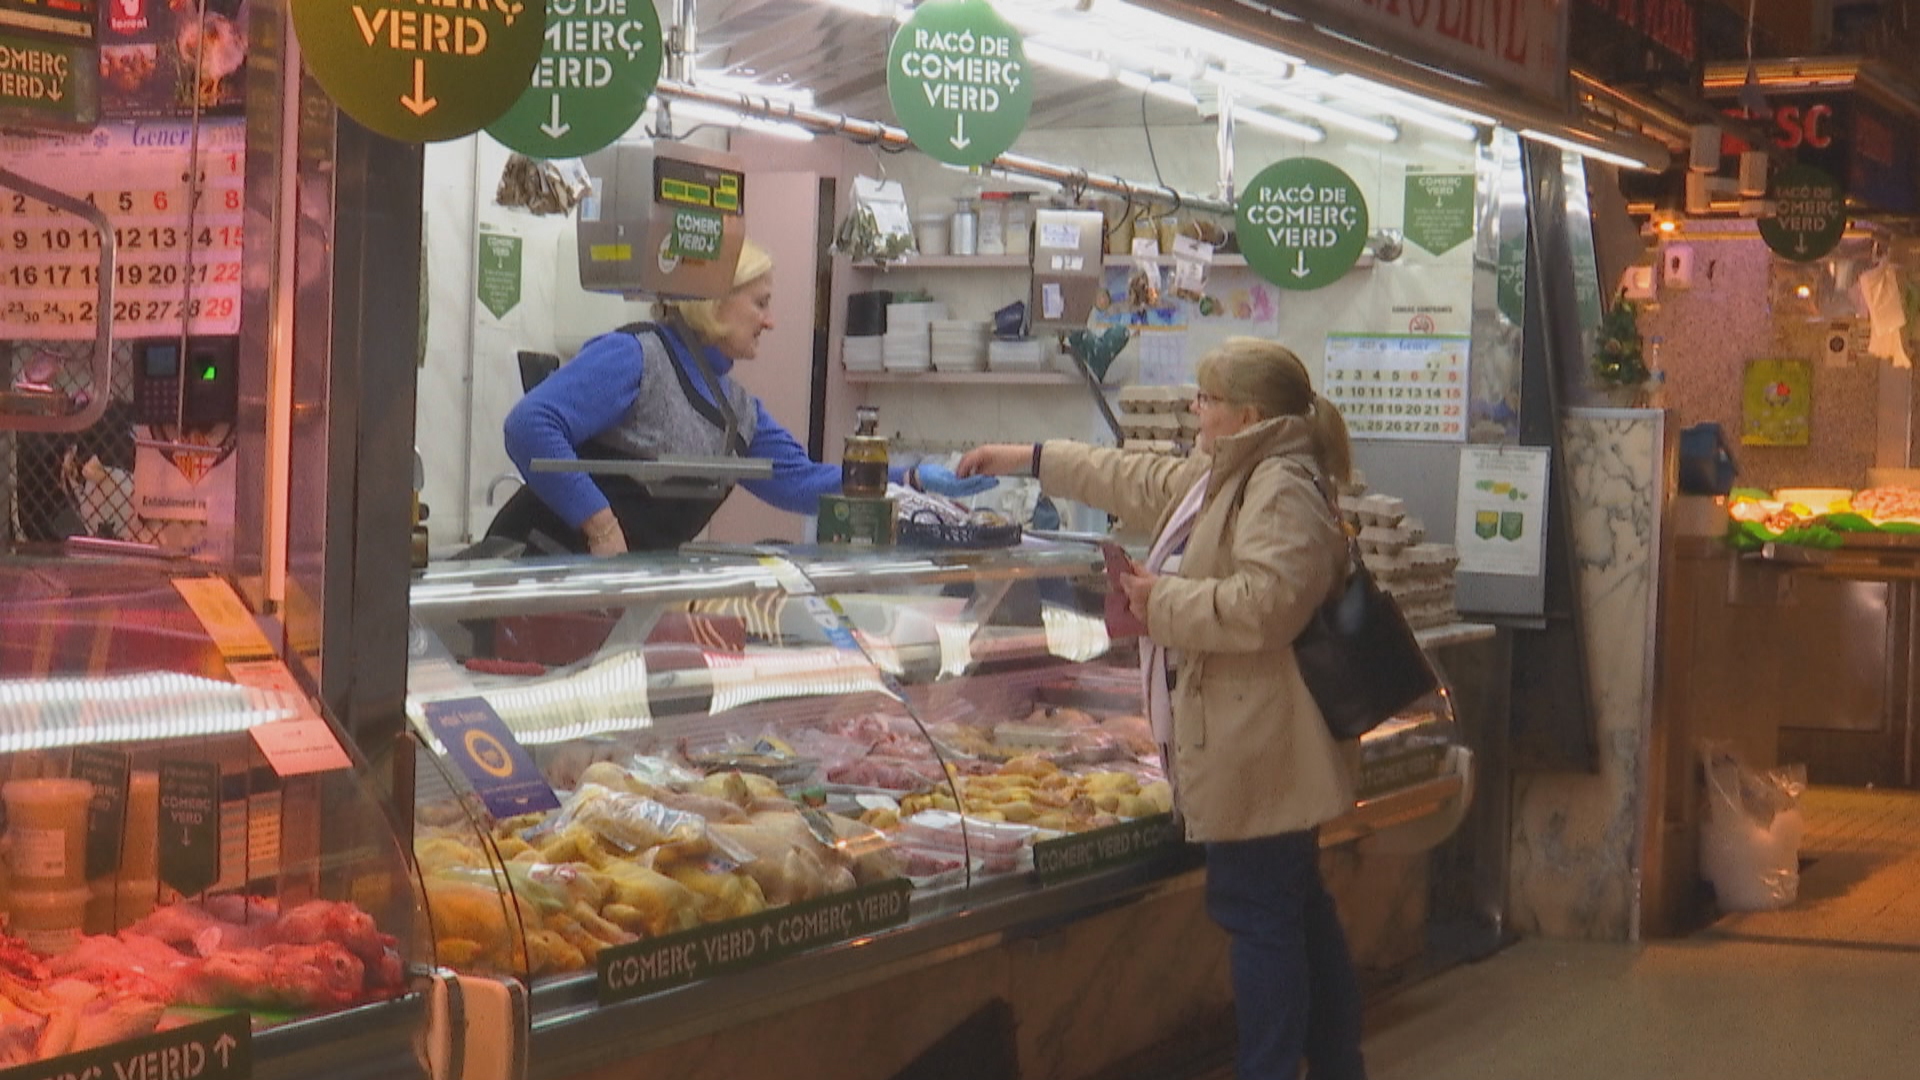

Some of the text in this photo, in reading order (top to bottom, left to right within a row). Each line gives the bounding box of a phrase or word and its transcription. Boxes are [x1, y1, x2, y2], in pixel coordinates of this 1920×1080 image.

[352, 5, 488, 55] VERD
[545, 20, 644, 61] MERÇ
[915, 28, 1009, 57] RACÓ DE
[0, 45, 68, 82] OMERÇ
[531, 57, 613, 88] ERD
[901, 51, 1021, 94] COMERÇ
[0, 73, 44, 98] ERD
[922, 81, 1000, 113] VERD
[12, 195, 26, 213] 2
[119, 192, 132, 212] 5
[153, 191, 168, 211] 6
[225, 190, 239, 209] 8
[1260, 183, 1347, 204] RACÓ DE
[1247, 204, 1357, 232] COMERÇ
[1777, 199, 1839, 220] OMERÇ
[677, 213, 721, 239] COMERÇ
[1778, 216, 1826, 232] VERD
[13, 230, 27, 249] 9
[42, 229, 71, 249] 10
[115, 228, 141, 248] 12
[150, 228, 176, 248] 13
[678, 232, 706, 250] VERD
[1267, 227, 1338, 247] VERD
[10, 266, 38, 285] 16
[44, 265, 71, 285] 17
[115, 265, 142, 285] 19
[149, 265, 177, 285] 20
[213, 263, 240, 282] 22
[114, 301, 141, 321] 26
[146, 300, 172, 320] 27
[206, 298, 233, 318] 29
[1336, 369, 1344, 380] 2
[1354, 369, 1362, 380] 3
[1372, 370, 1381, 380] 4
[1392, 370, 1400, 381] 5
[1430, 371, 1438, 382] 7
[1336, 386, 1343, 396] 9
[1352, 387, 1365, 398] 10
[1370, 387, 1382, 398] 11
[1389, 388, 1403, 398] 12
[1408, 388, 1422, 398] 13
[1427, 388, 1441, 398] 14
[1351, 404, 1364, 414] 17
[1370, 404, 1384, 414] 18
[1387, 404, 1402, 414] 19
[1406, 404, 1422, 415] 20
[1424, 405, 1440, 415] 21
[1444, 406, 1460, 416] 22
[1368, 420, 1382, 430] 25
[1386, 420, 1402, 431] 26
[1405, 421, 1420, 432] 27
[1424, 422, 1440, 432] 28
[1097, 832, 1130, 858] VERD
[607, 891, 900, 989] COMERÇ VERD COMERÇ VERD
[112, 1041, 206, 1080] VERD
